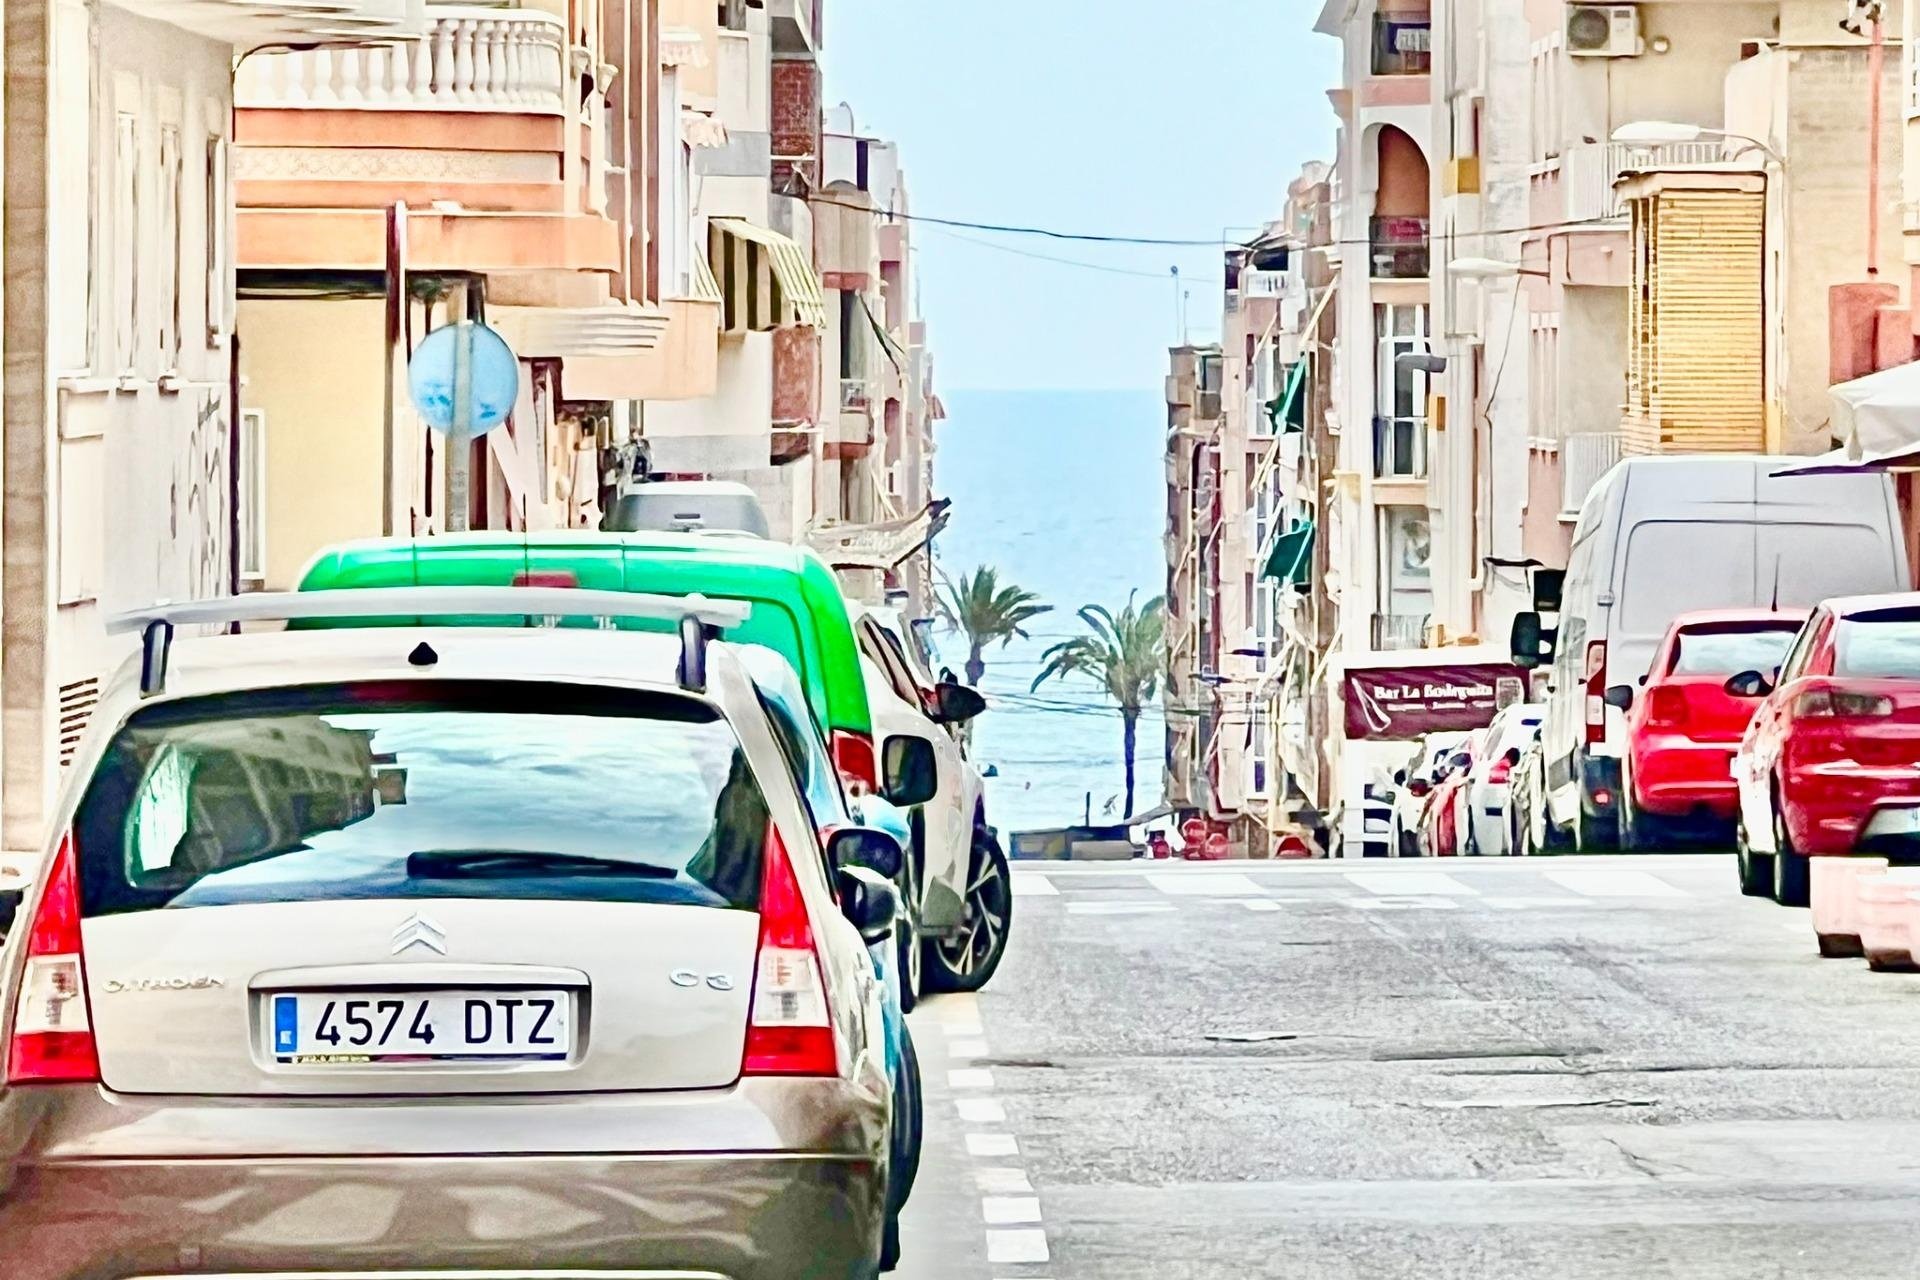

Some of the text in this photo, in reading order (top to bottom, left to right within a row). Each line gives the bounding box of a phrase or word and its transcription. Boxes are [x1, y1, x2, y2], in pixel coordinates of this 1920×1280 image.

[1373, 686, 1400, 699] Bar
[1402, 685, 1420, 698] La
[315, 999, 555, 1046] 4574 DTZ
